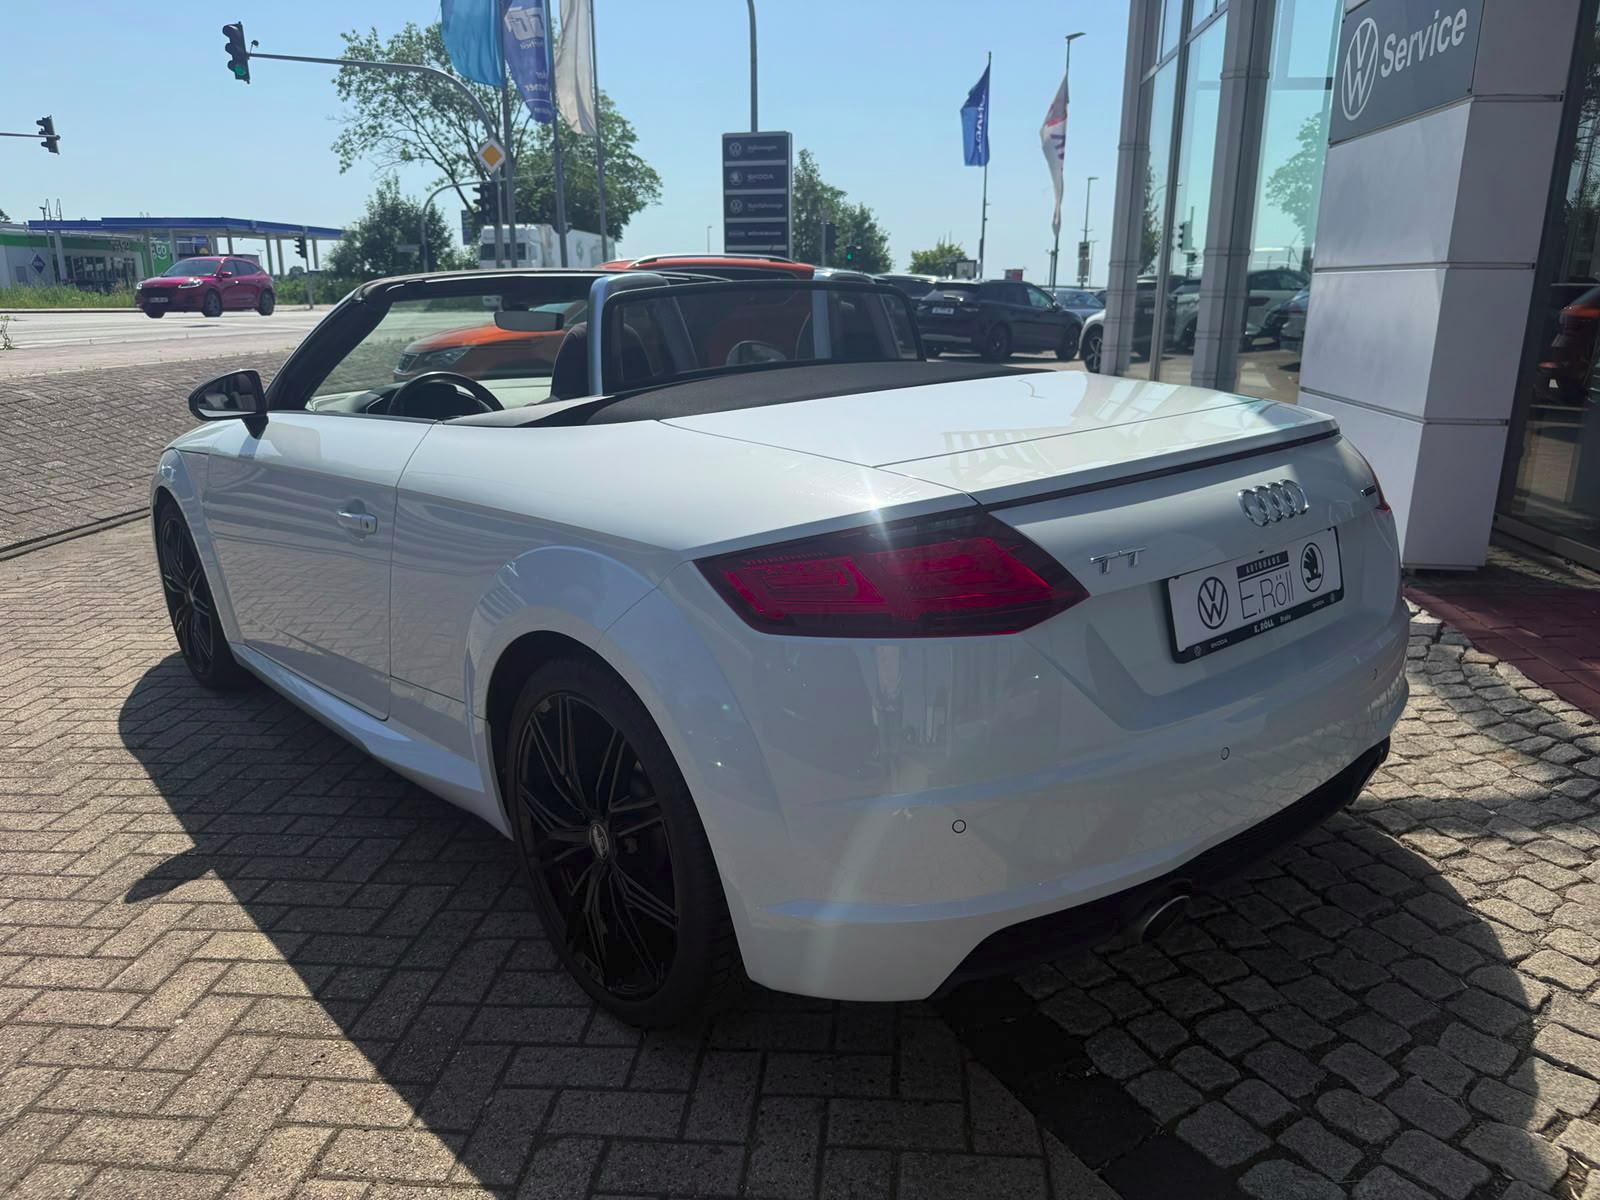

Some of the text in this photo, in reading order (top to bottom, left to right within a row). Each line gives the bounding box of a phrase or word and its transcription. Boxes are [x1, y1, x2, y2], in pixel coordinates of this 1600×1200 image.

[1380, 8, 1467, 78] Service
[1089, 546, 1147, 575] TT
[1246, 554, 1281, 574] AUTOHAUS
